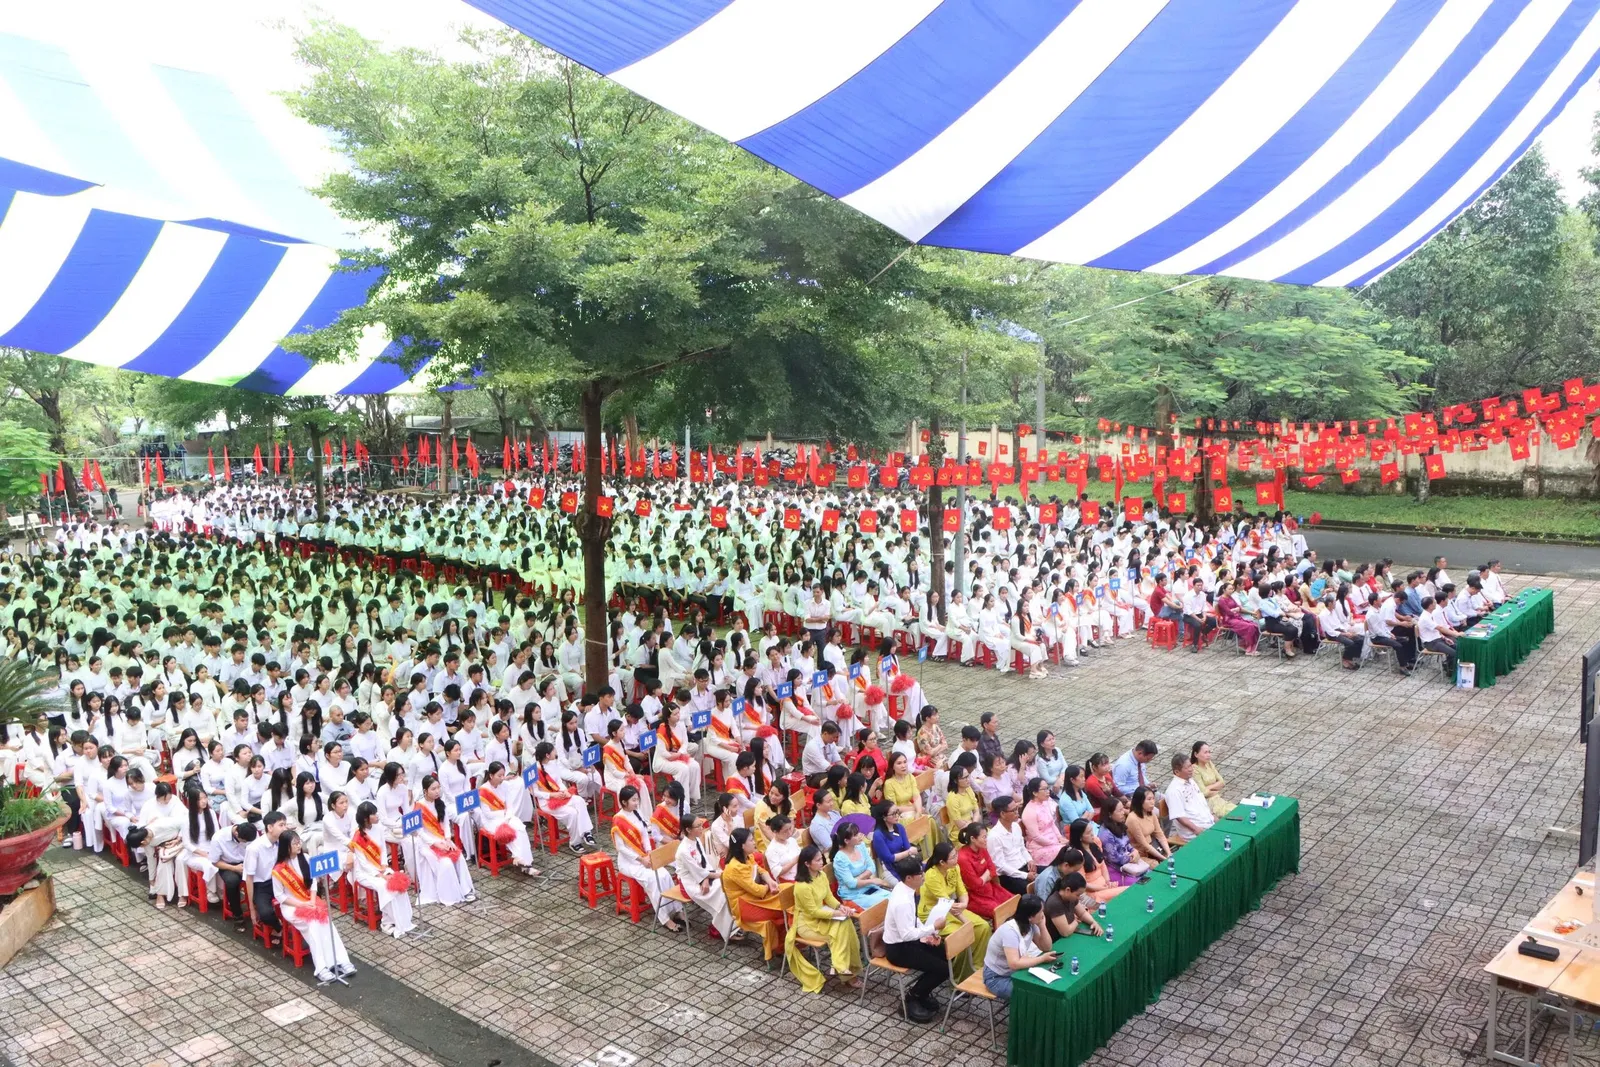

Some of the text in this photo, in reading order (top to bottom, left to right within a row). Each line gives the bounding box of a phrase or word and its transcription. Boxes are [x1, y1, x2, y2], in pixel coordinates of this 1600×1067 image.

[853, 667, 859, 676] A1
[817, 674, 825, 684] A2
[782, 686, 789, 695] A3
[736, 701, 743, 712] A4
[698, 715, 707, 725] A5
[644, 734, 653, 746] A6
[587, 750, 596, 762] A7
[528, 769, 536, 782] A8
[462, 795, 474, 808] A9
[405, 814, 420, 830] A10
[315, 856, 335, 872] A11
